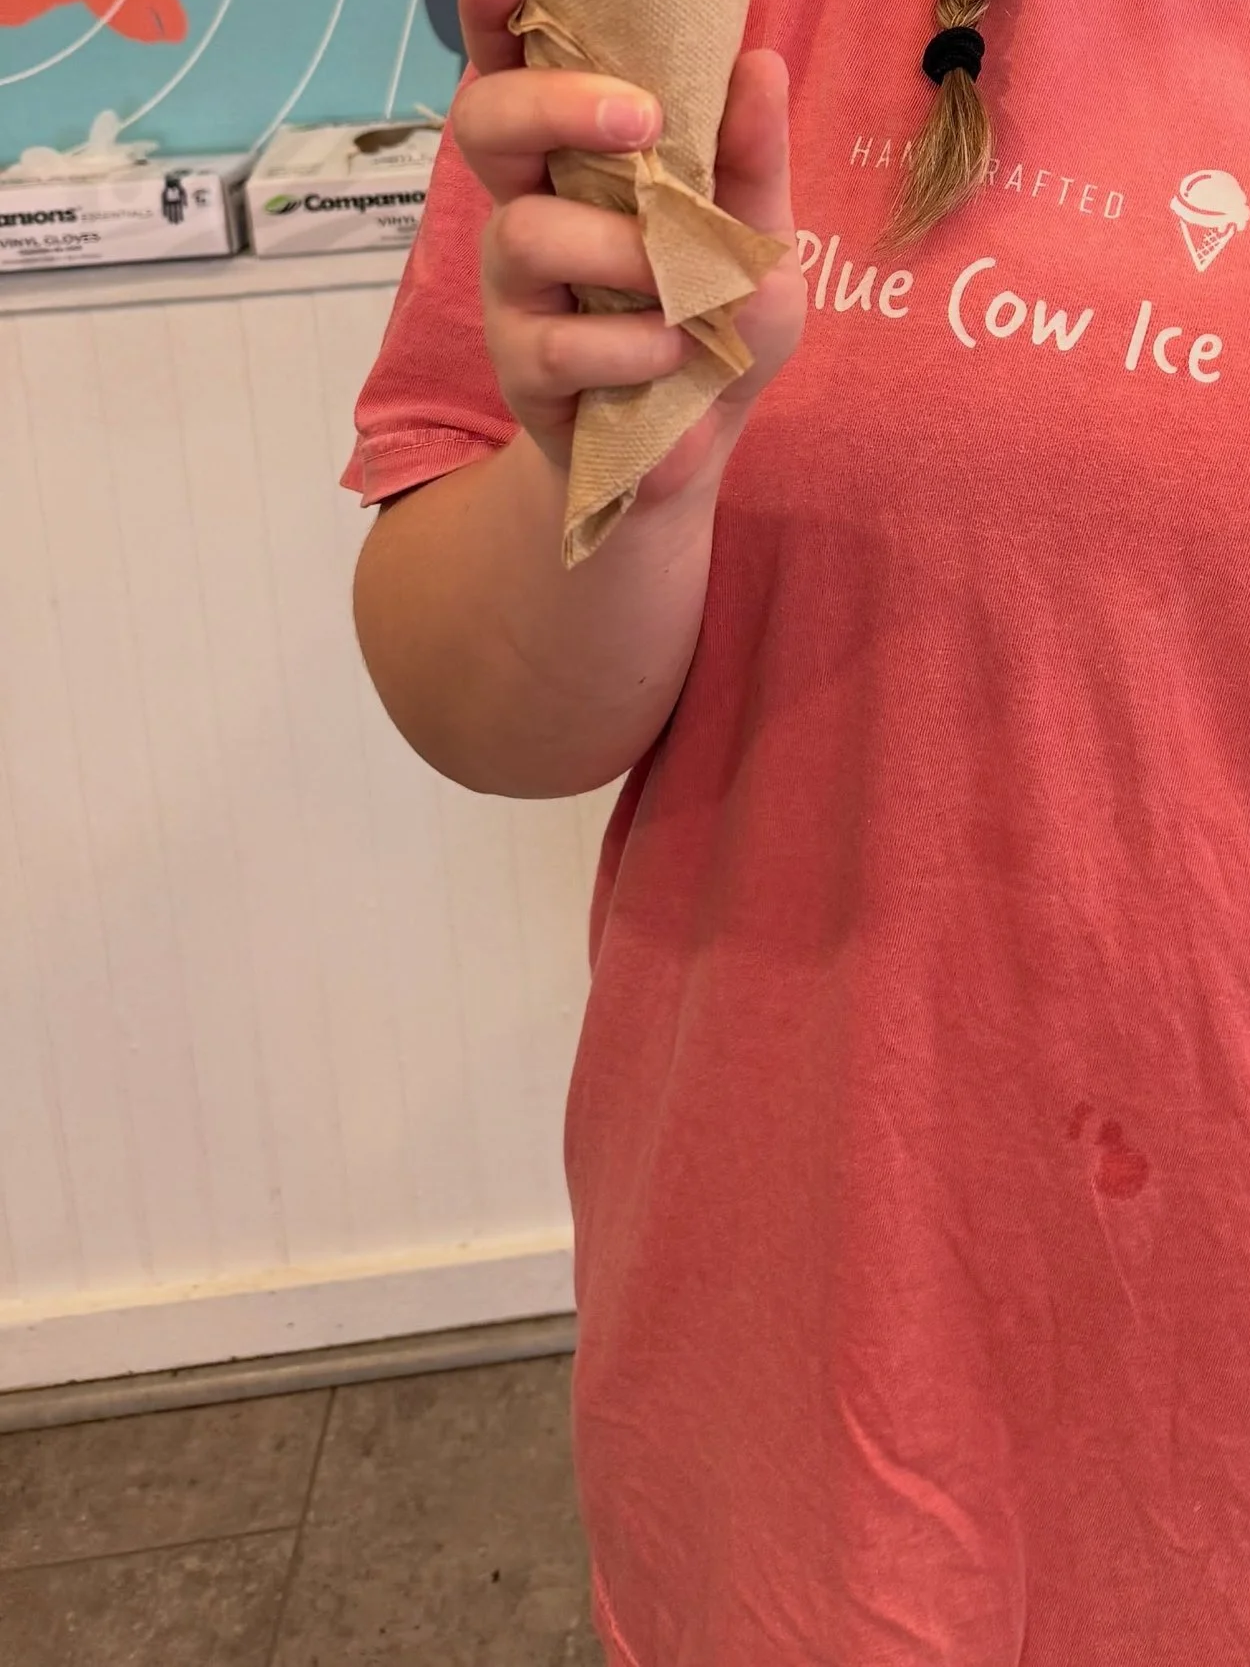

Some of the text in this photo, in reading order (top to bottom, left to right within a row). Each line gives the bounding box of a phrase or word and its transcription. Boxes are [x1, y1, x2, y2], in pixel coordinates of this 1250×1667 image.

[304, 190, 426, 212] Companio
[849, 135, 1124, 220] HANRAFTED
[44, 232, 101, 246] GLOVES
[948, 257, 1094, 352] Cow
[1125, 301, 1223, 384] Ice
